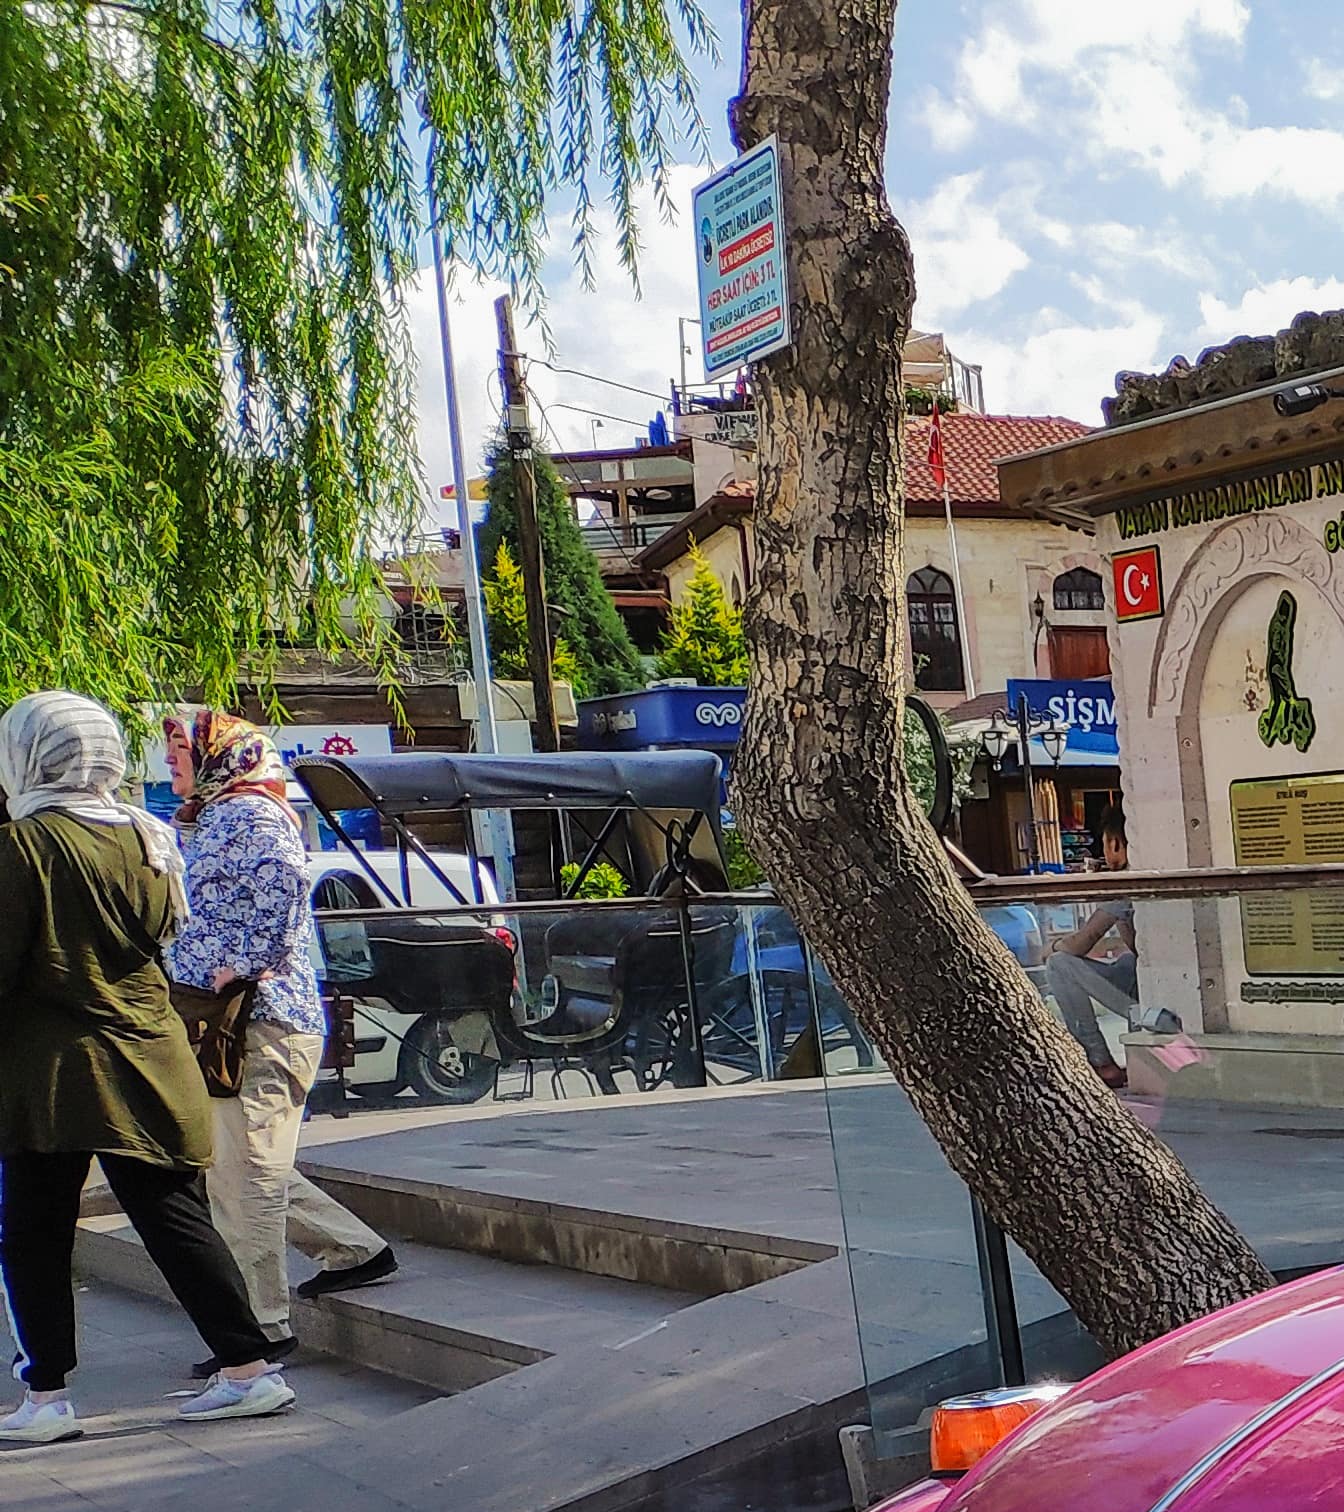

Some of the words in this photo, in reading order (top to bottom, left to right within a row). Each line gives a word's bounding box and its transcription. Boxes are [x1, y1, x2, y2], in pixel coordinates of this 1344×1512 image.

[707, 288, 721, 312] HER
[722, 277, 740, 303] SAAT
[766, 258, 775, 280] TL
[733, 302, 746, 321] SAAT
[1116, 499, 1168, 539] VATAN
[1171, 469, 1313, 527] KAHRAMANLARI
